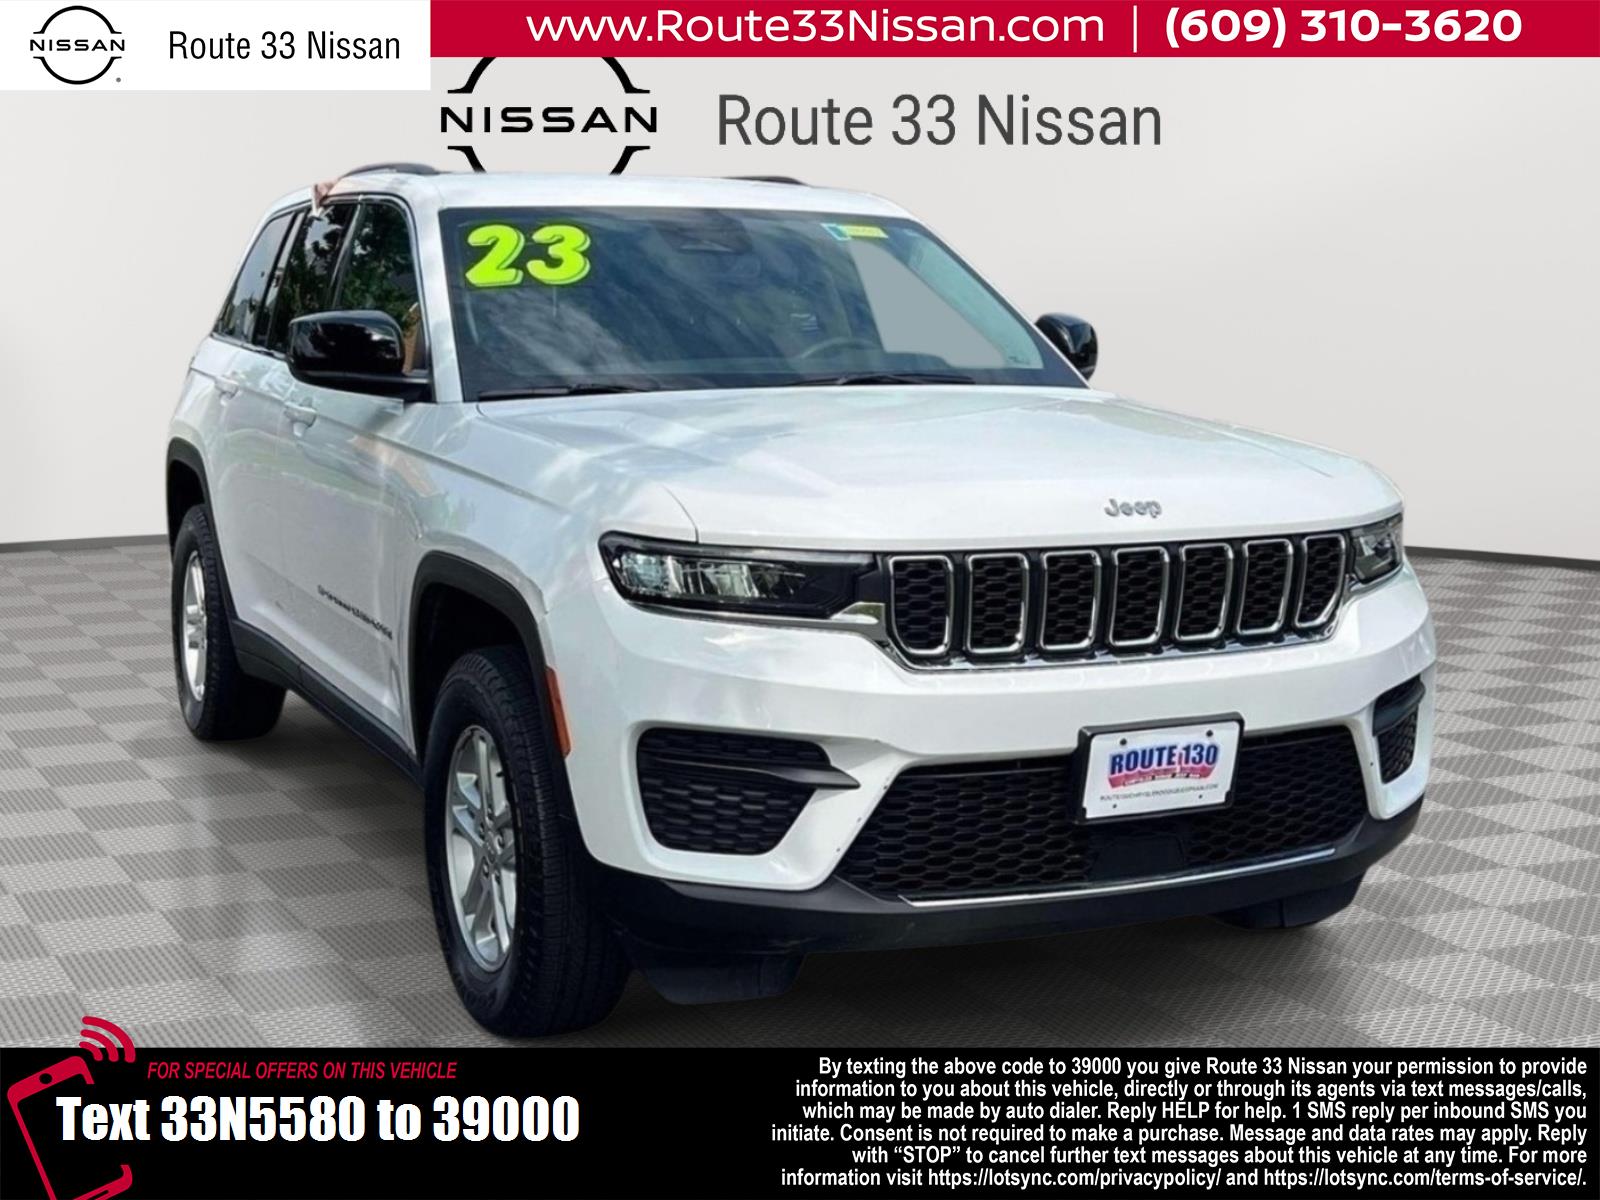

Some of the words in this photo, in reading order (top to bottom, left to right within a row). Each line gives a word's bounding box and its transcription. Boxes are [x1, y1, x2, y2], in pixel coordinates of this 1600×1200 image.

[464, 224, 592, 288] 23
[1104, 498, 1162, 519] Jeep
[1109, 743, 1177, 776] ROUTE
[1182, 742, 1220, 767] 130
